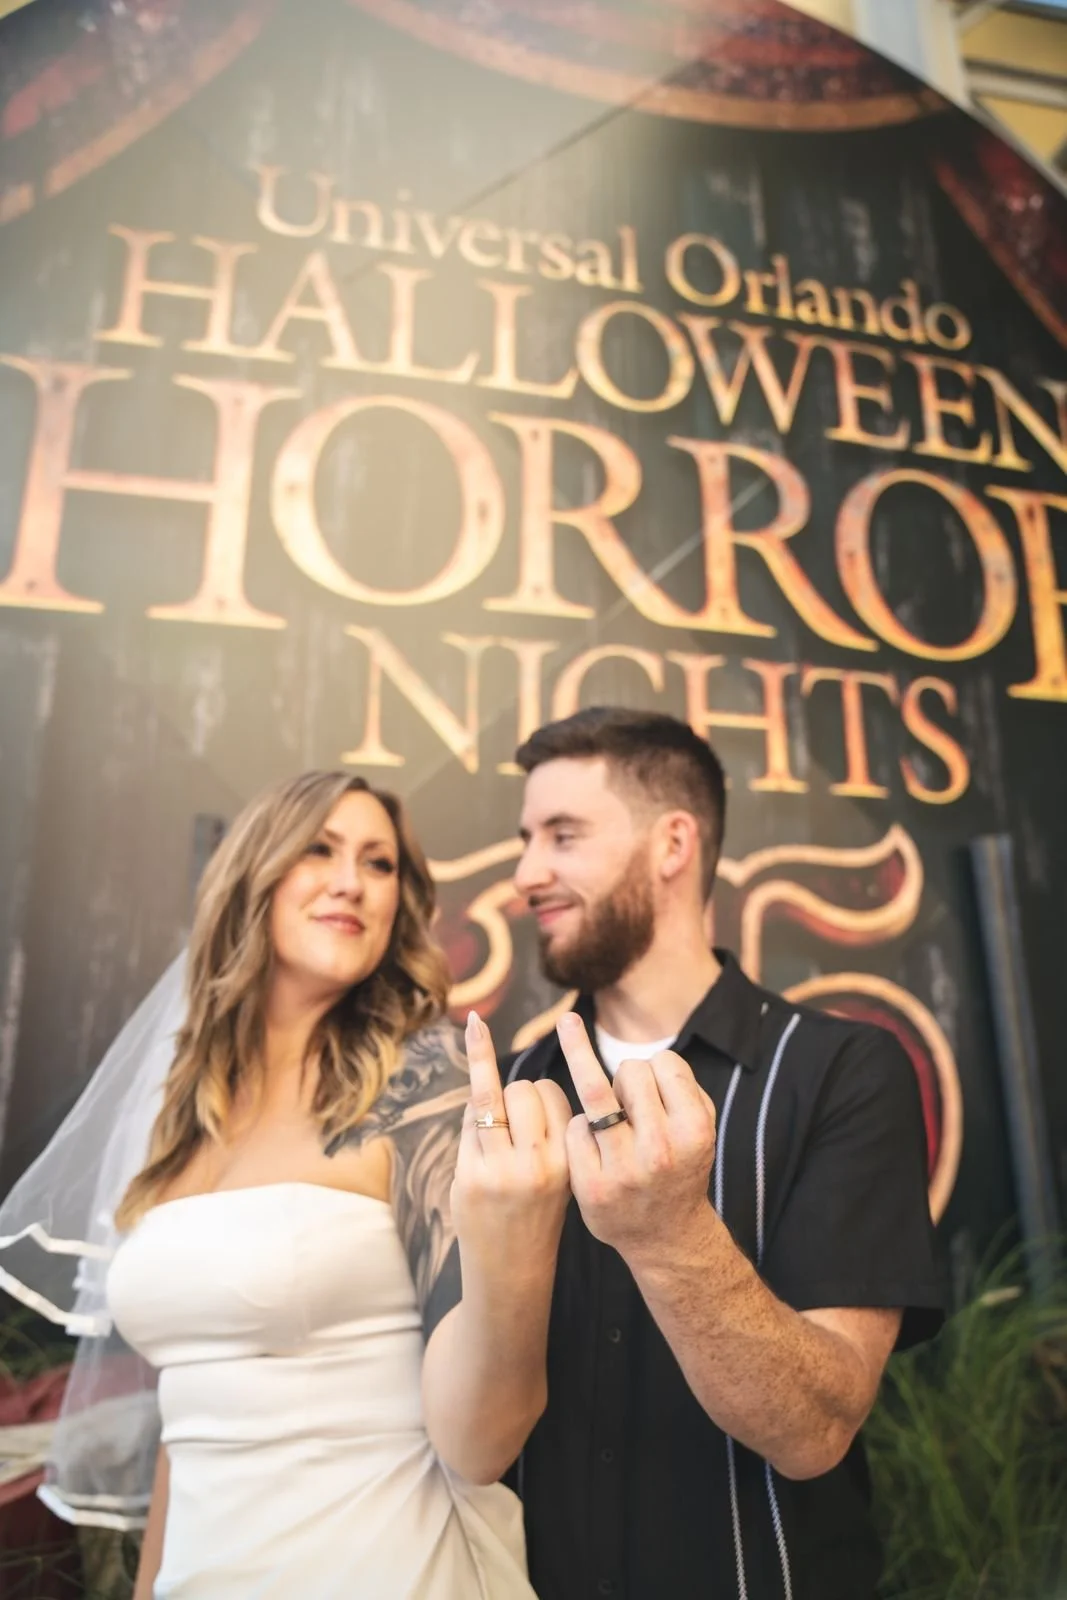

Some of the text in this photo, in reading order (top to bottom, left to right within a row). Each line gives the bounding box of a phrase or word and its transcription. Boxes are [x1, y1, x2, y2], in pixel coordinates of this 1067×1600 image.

[94, 224, 1067, 475] HALLOWEEN
[251, 165, 971, 350] Universal Orlando
